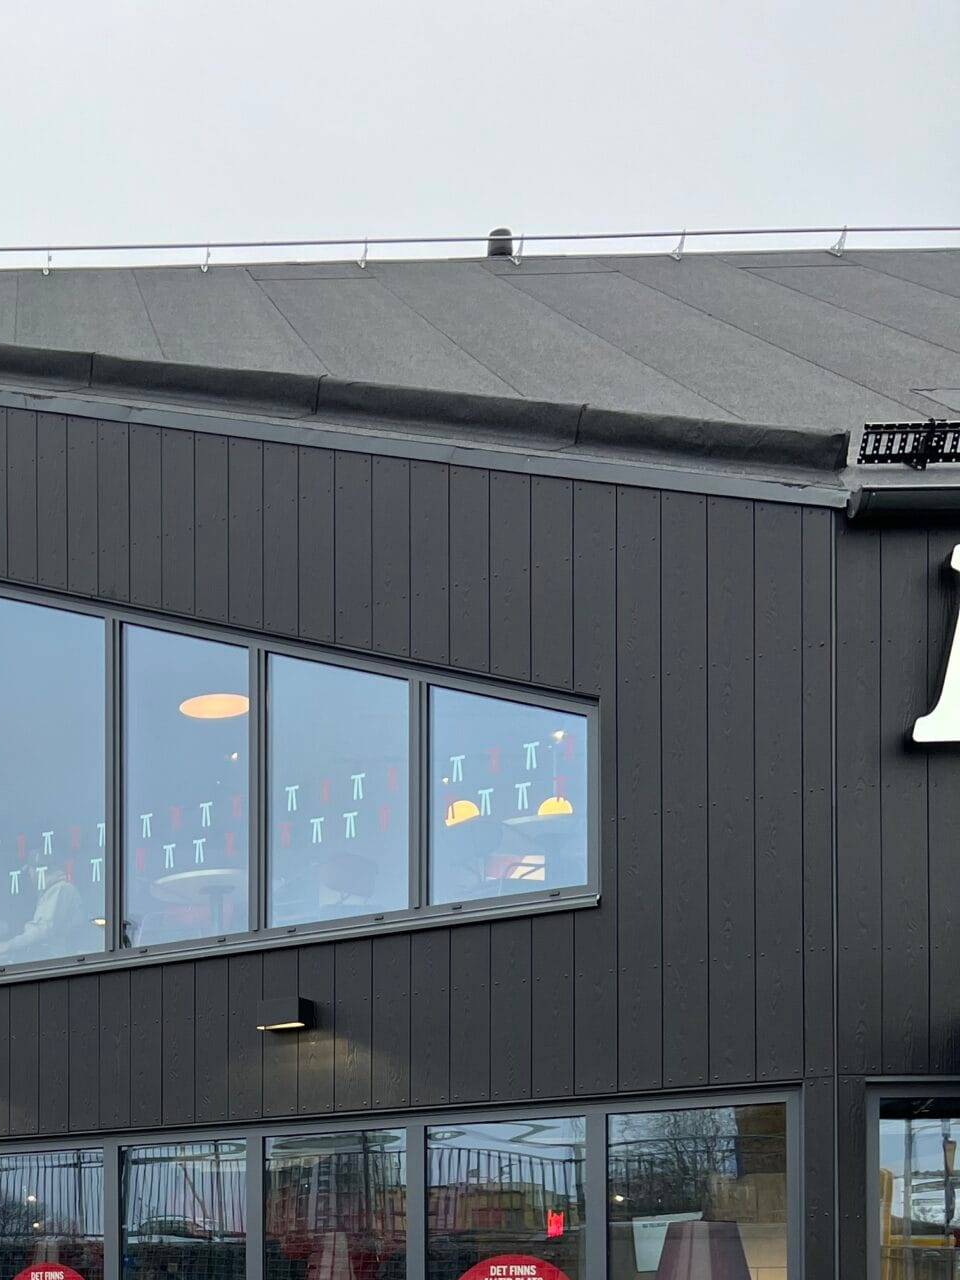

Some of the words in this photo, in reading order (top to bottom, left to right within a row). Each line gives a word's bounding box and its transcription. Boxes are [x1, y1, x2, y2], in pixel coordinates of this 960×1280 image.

[31, 1271, 43, 1280] DET
[44, 1271, 64, 1280] FINNS
[490, 1265, 507, 1276] DET
[509, 1265, 536, 1276] FINNS
